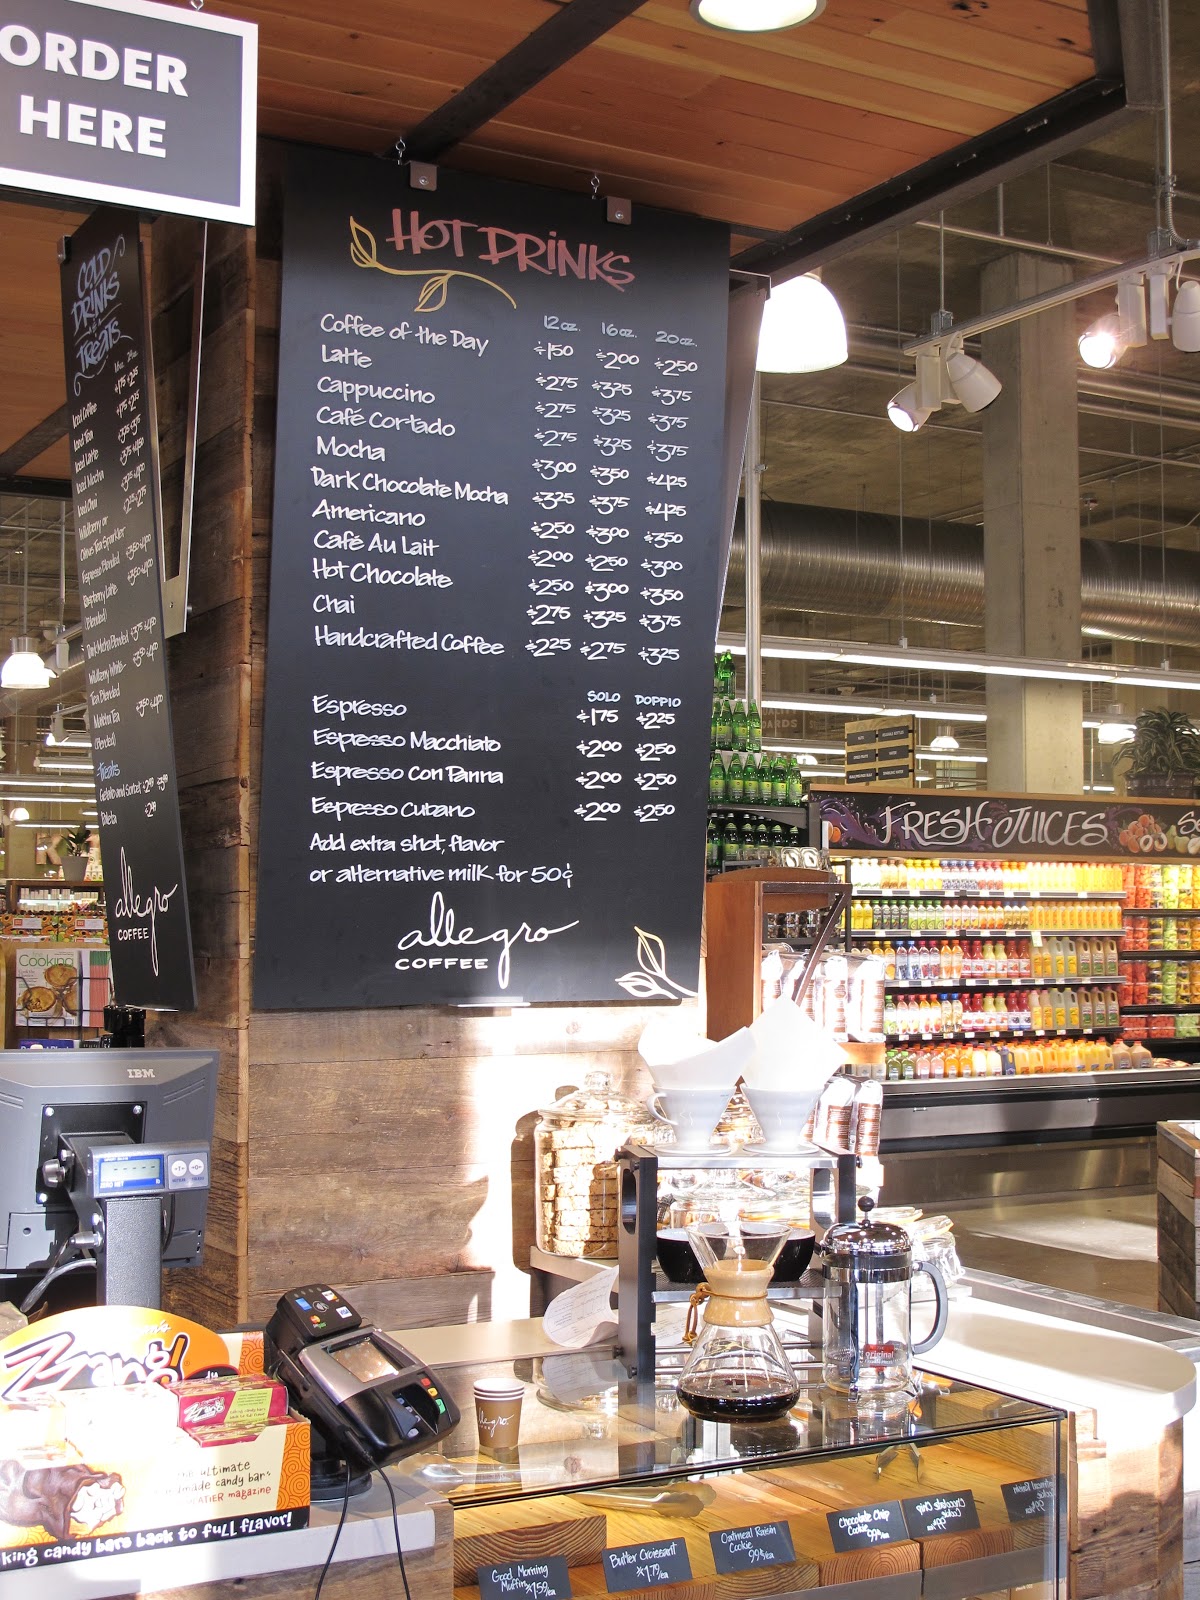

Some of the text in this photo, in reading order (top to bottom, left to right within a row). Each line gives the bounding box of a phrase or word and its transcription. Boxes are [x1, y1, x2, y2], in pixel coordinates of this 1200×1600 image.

[0, 24, 188, 97] ORDER
[20, 95, 166, 158] HERE
[386, 208, 636, 292] HOT DRINKS
[77, 247, 111, 299] COLD
[320, 313, 489, 357] Coffee of the Day
[322, 344, 372, 368] Latte
[317, 376, 436, 404] Cappuccino
[316, 406, 456, 436] Café Cortado
[316, 435, 386, 461] Mocha
[310, 466, 508, 505] Dark Chocolate Mocha
[312, 499, 425, 526] Americano
[313, 530, 440, 556] Café Au Lait
[313, 558, 453, 588] Hot Chocolate
[313, 594, 355, 614] Chai
[315, 625, 505, 655] Handcrafted Coffee
[312, 694, 407, 721] Espresso
[587, 690, 621, 702] SOLO
[634, 694, 681, 707] DOPPIO
[313, 728, 501, 752] Espresso Macchiato
[311, 761, 504, 786] Espresso Con Panna
[311, 797, 475, 821] Espresso Cubano
[880, 800, 1110, 848] FRESH JUICES
[309, 832, 505, 855] Add extra shot, flavor
[309, 869, 333, 882] or
[335, 864, 444, 883] alternative
[449, 864, 494, 882] milk
[496, 864, 528, 883] for
[115, 846, 178, 976] allegro
[118, 928, 149, 941] COFFEE
[397, 891, 580, 989] allegro
[395, 958, 488, 971] COFFEE
[127, 1068, 155, 1078] IBM
[216, 1474, 244, 1487] candy
[228, 1485, 271, 1500] magazine
[839, 1509, 890, 1528] Chocolate Chip
[848, 1523, 868, 1536] Cookie
[44, 1539, 91, 1560] candy
[96, 1536, 132, 1553] bars
[136, 1530, 173, 1546] back
[178, 1526, 197, 1541] to
[202, 1520, 237, 1538] full
[240, 1512, 292, 1533] flavor!
[721, 1525, 776, 1544] Oatmeal Raisin
[729, 1540, 754, 1553] Cookie
[609, 1542, 677, 1568] Butter Croissant
[492, 1565, 548, 1582] Good Morning
